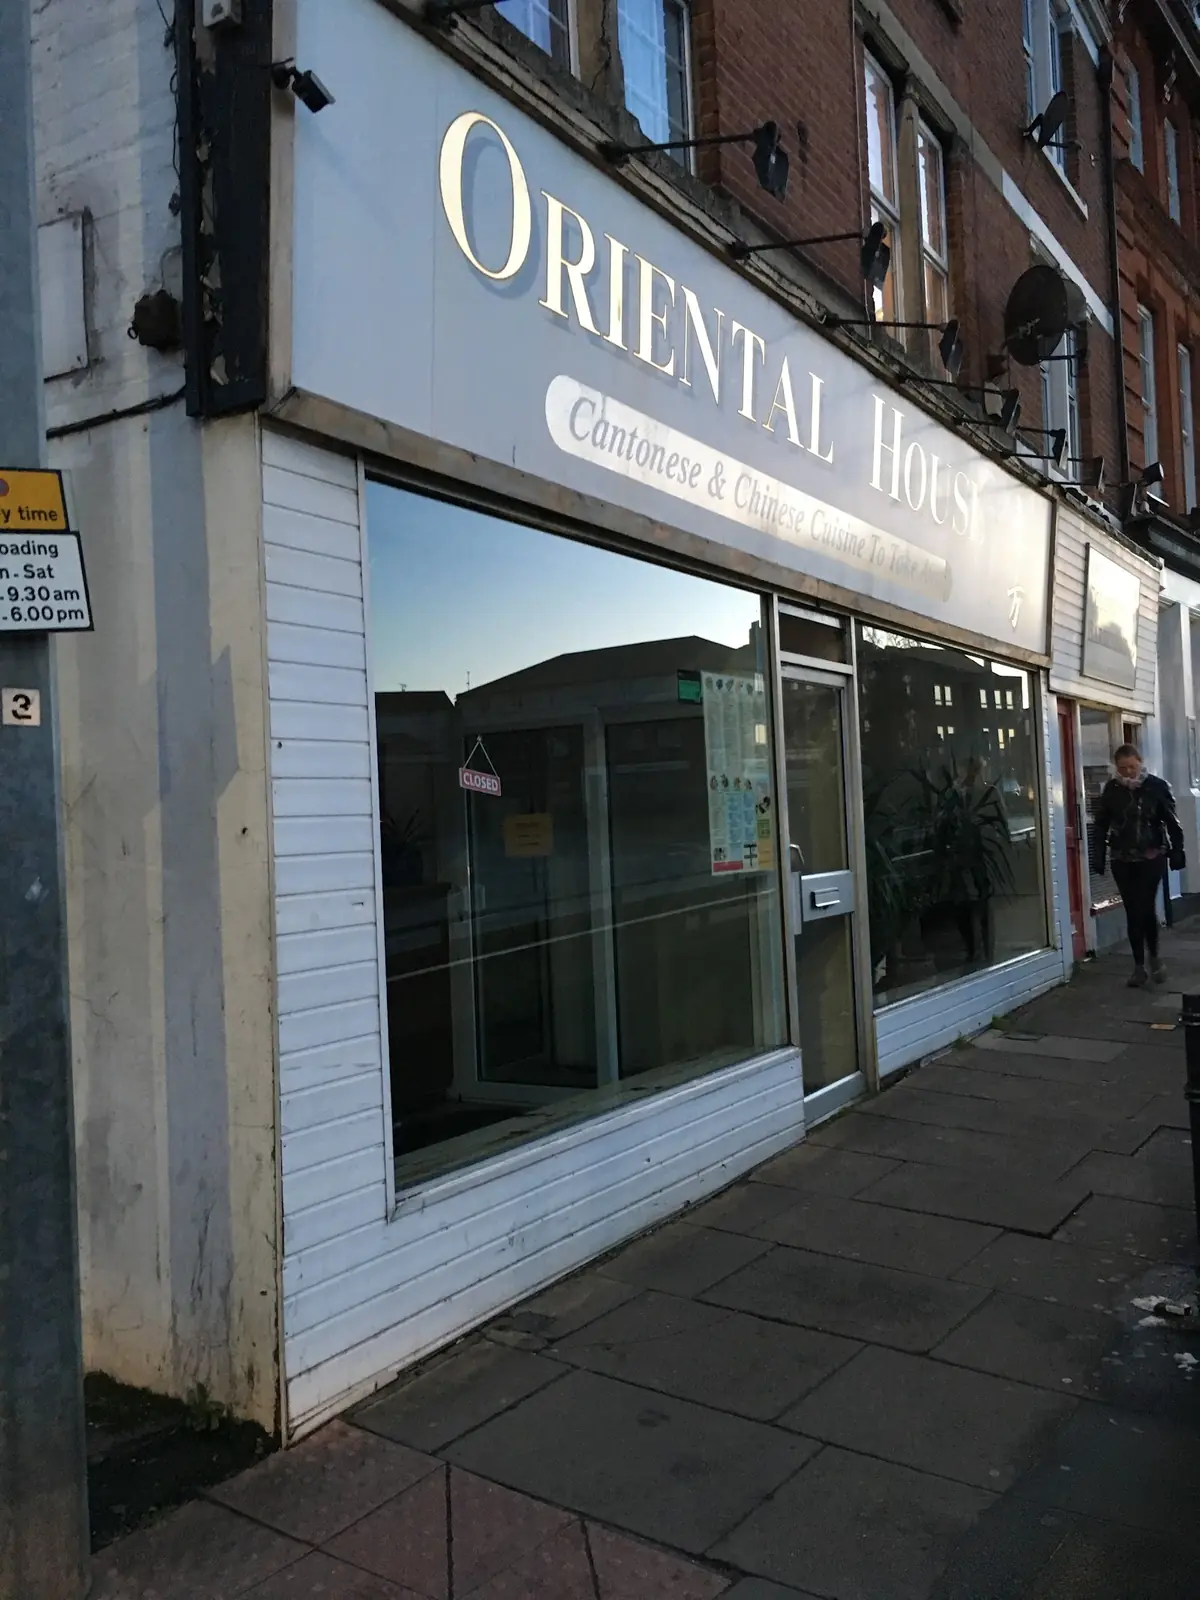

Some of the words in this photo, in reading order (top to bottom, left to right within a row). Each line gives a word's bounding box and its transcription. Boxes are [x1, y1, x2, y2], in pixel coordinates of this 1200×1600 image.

[438, 109, 833, 464] ORIENTAL
[569, 396, 703, 489] Cantonese
[707, 460, 727, 501] &
[734, 472, 805, 533] Chinese
[810, 508, 867, 560] Cuisine
[869, 533, 886, 568] To
[17, 504, 58, 521] time
[23, 563, 55, 579] Sat
[463, 772, 499, 792] CLOSED
